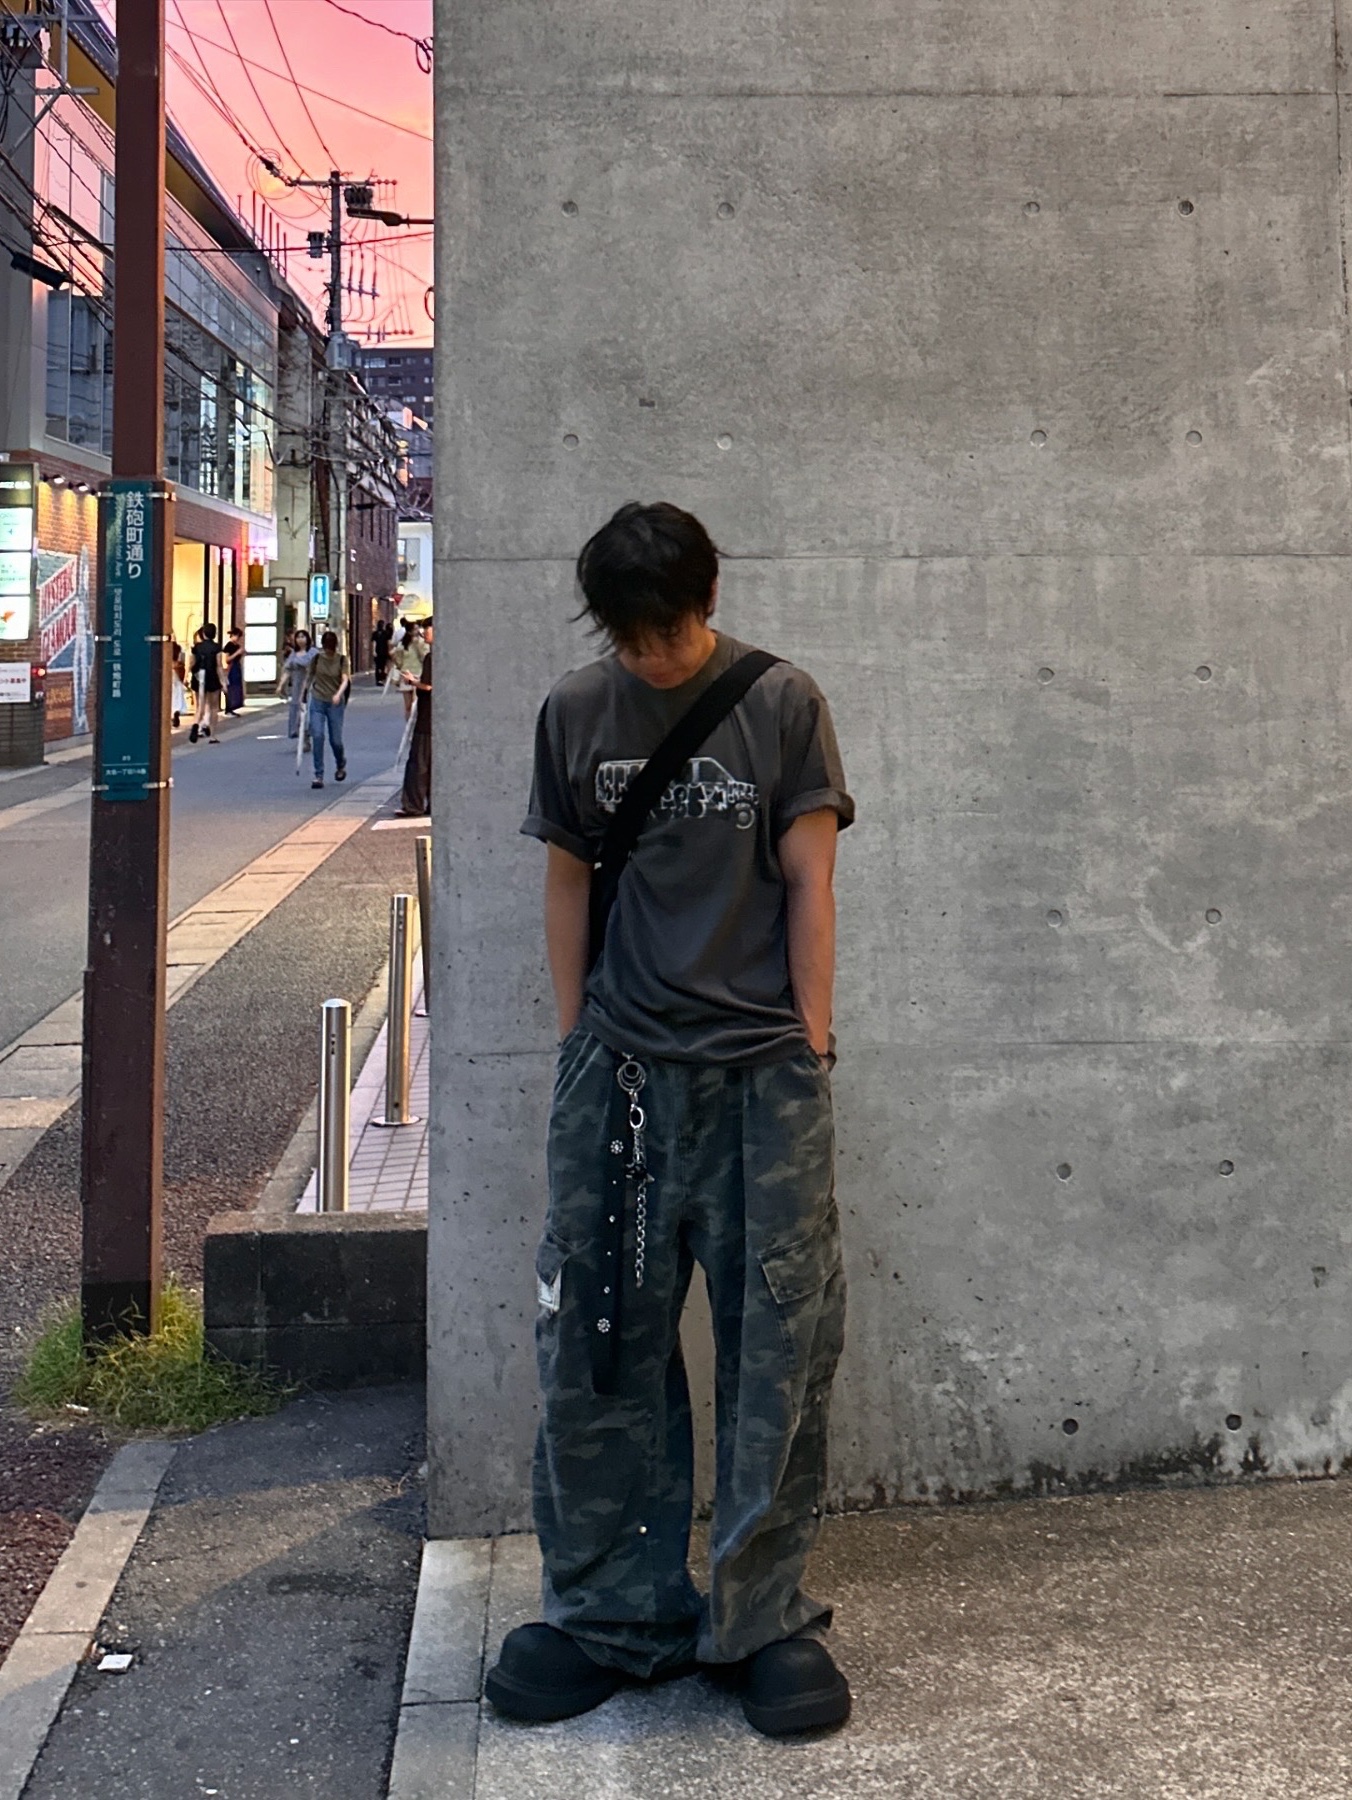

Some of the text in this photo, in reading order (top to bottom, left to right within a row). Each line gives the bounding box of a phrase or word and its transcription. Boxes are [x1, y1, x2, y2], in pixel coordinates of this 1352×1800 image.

[126, 490, 145, 579] 鉄砲町通り
